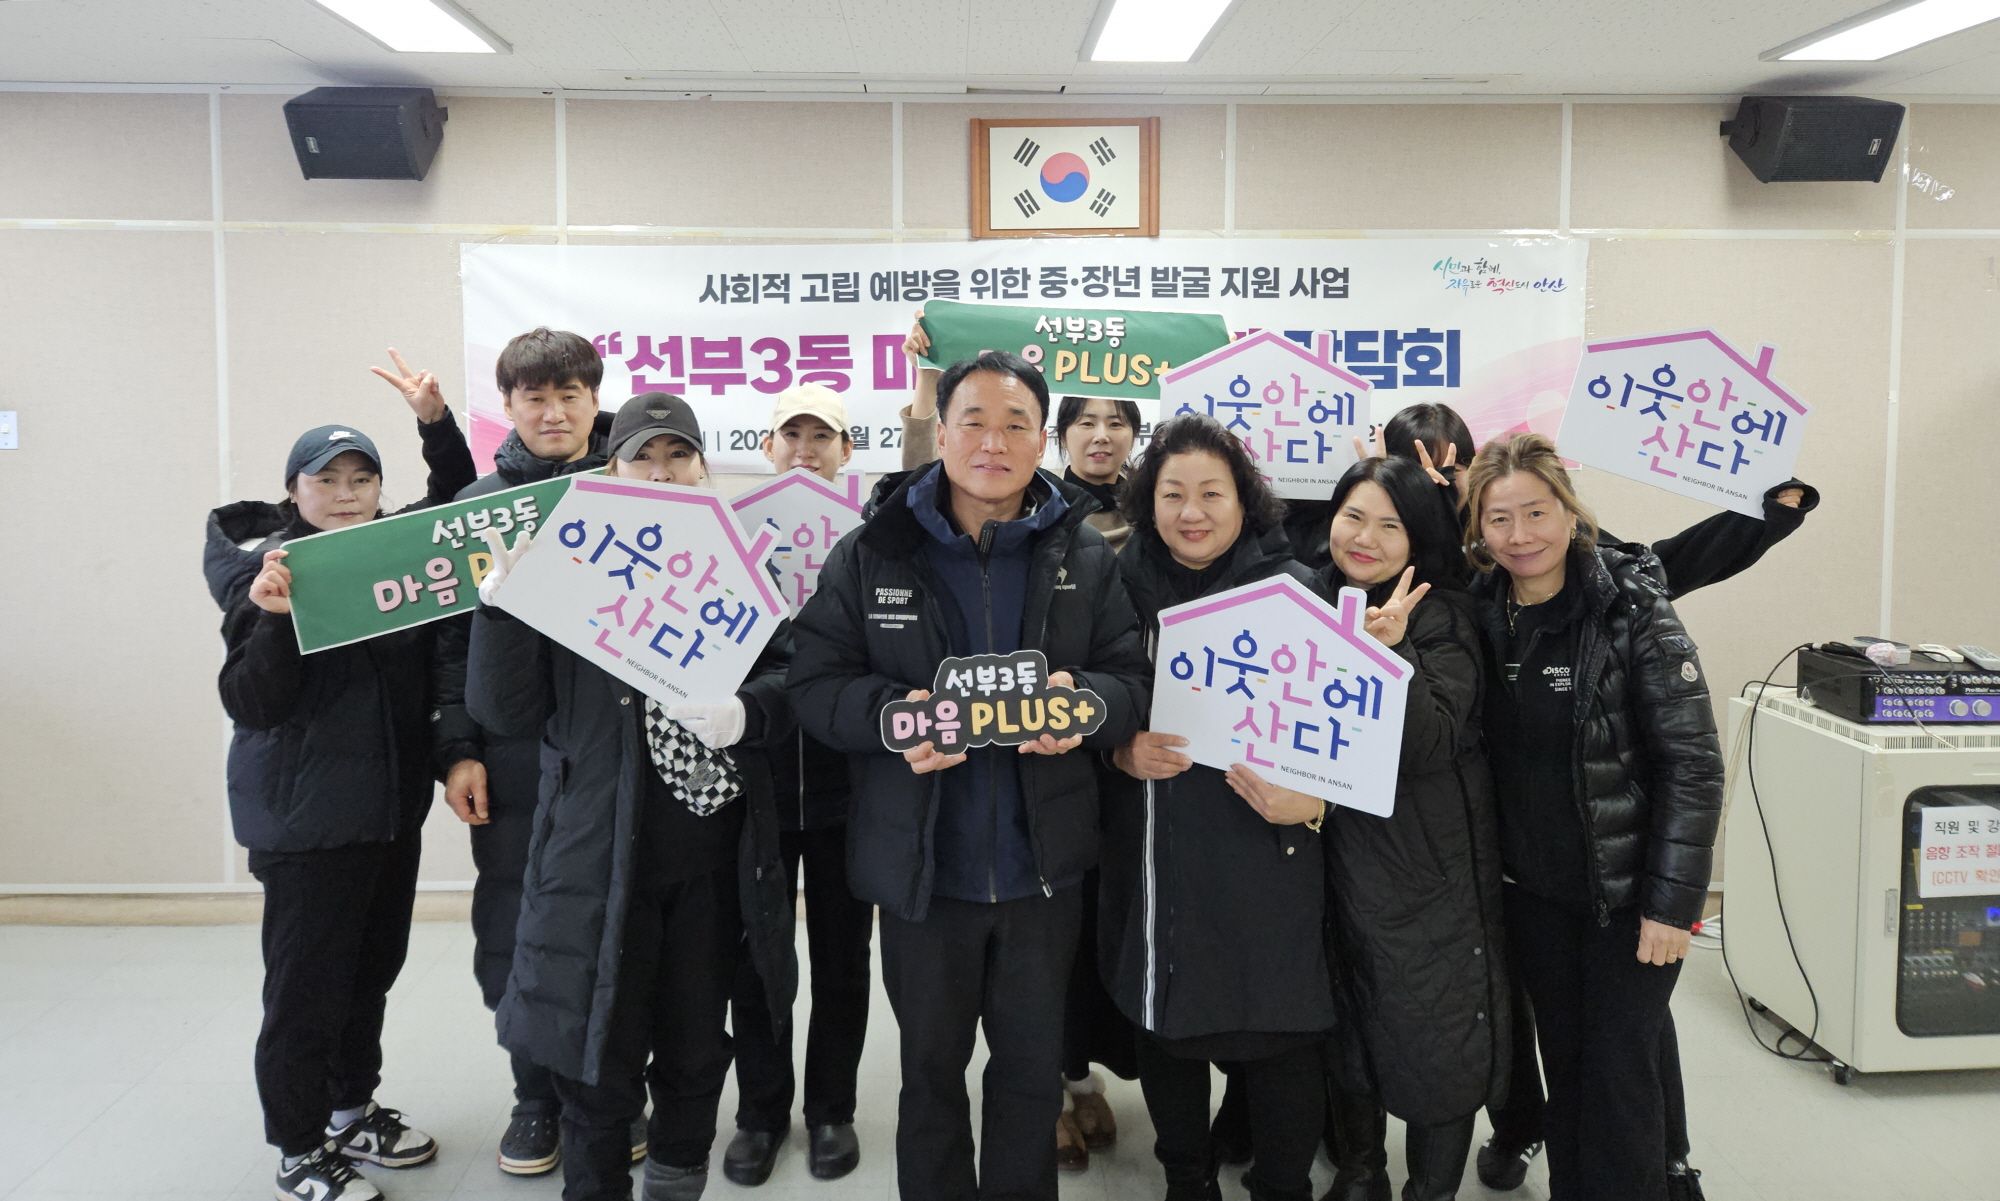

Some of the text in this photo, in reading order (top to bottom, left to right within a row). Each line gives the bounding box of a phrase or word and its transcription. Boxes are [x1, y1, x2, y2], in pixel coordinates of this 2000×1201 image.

[699, 265, 1350, 304] 사회적 고립 예방을 위한 중·장년 발굴 지원 사업
[1433, 257, 1473, 279] 시민과
[1445, 277, 1568, 297] 자유로운 혁신도시 안산
[1034, 314, 1128, 349] 선부3동
[1054, 349, 1174, 387] PLUS+
[1587, 363, 1788, 447] 이웃안에
[1640, 422, 1751, 479] 산다
[1682, 475, 1748, 500] NEIGHBOR IN ANSAN
[432, 495, 540, 550] 선부3동
[372, 556, 461, 613] 마음
[875, 587, 914, 598] PASSIONNE
[878, 596, 909, 605] DE SPORT
[593, 593, 705, 669] 산다
[626, 658, 689, 699] NEIGHBOR IN ANSAN
[945, 661, 1038, 698] 선부3동
[1169, 629, 1384, 721] 이웃안에
[1542, 666, 1571, 675] DISCO
[892, 696, 1095, 745] 마음 PLUS+
[1231, 699, 1350, 770] 산다
[1280, 765, 1353, 791] NEIGHBOR IN ANSAN
[1935, 820, 1960, 836] 직원
[1968, 820, 1980, 835] 및
[1926, 846, 1951, 861] 음향
[1955, 844, 1980, 859] 조작
